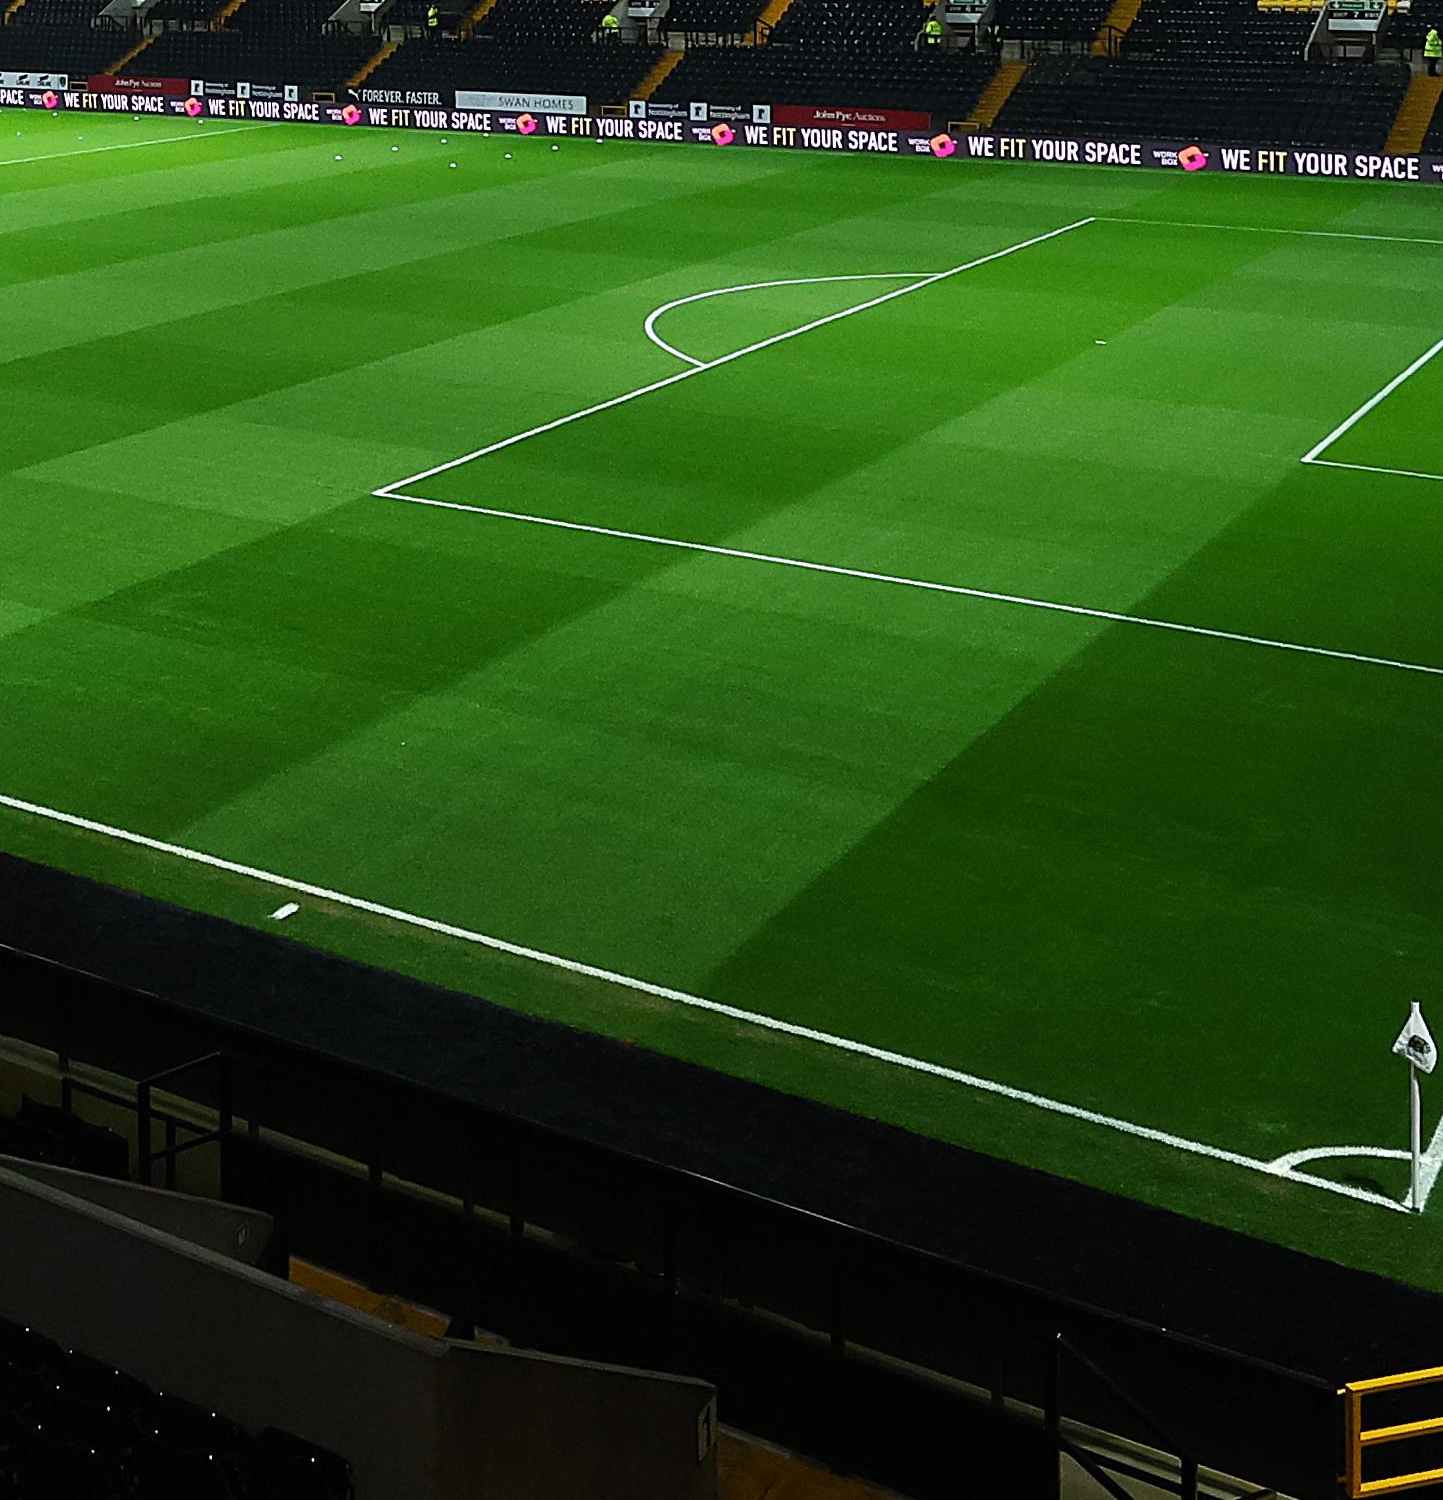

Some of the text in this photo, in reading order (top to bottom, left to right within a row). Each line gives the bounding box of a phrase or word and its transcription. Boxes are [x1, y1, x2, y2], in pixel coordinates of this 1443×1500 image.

[64, 92, 80, 108] WE
[82, 93, 98, 109] FIT
[101, 94, 129, 111] YOUR
[131, 95, 164, 112] SPACE
[362, 88, 442, 106] FOREVER. FASTER.
[498, 96, 574, 110] SWAN HOMES
[208, 99, 319, 120] WE FIT YOUR SPACE
[368, 108, 492, 131] WE FIT YOUR SPACE
[813, 109, 834, 121] John
[546, 116, 683, 140] WE FIT YOUR SPACE
[744, 125, 899, 152] WE FIT YOUR SPACE
[968, 136, 1141, 165] WE FIT YOUR SPACE
[1153, 150, 1178, 159] WORK
[1161, 157, 1178, 166] BOX
[1221, 148, 1419, 180] WE FIT YOUR SPACE
